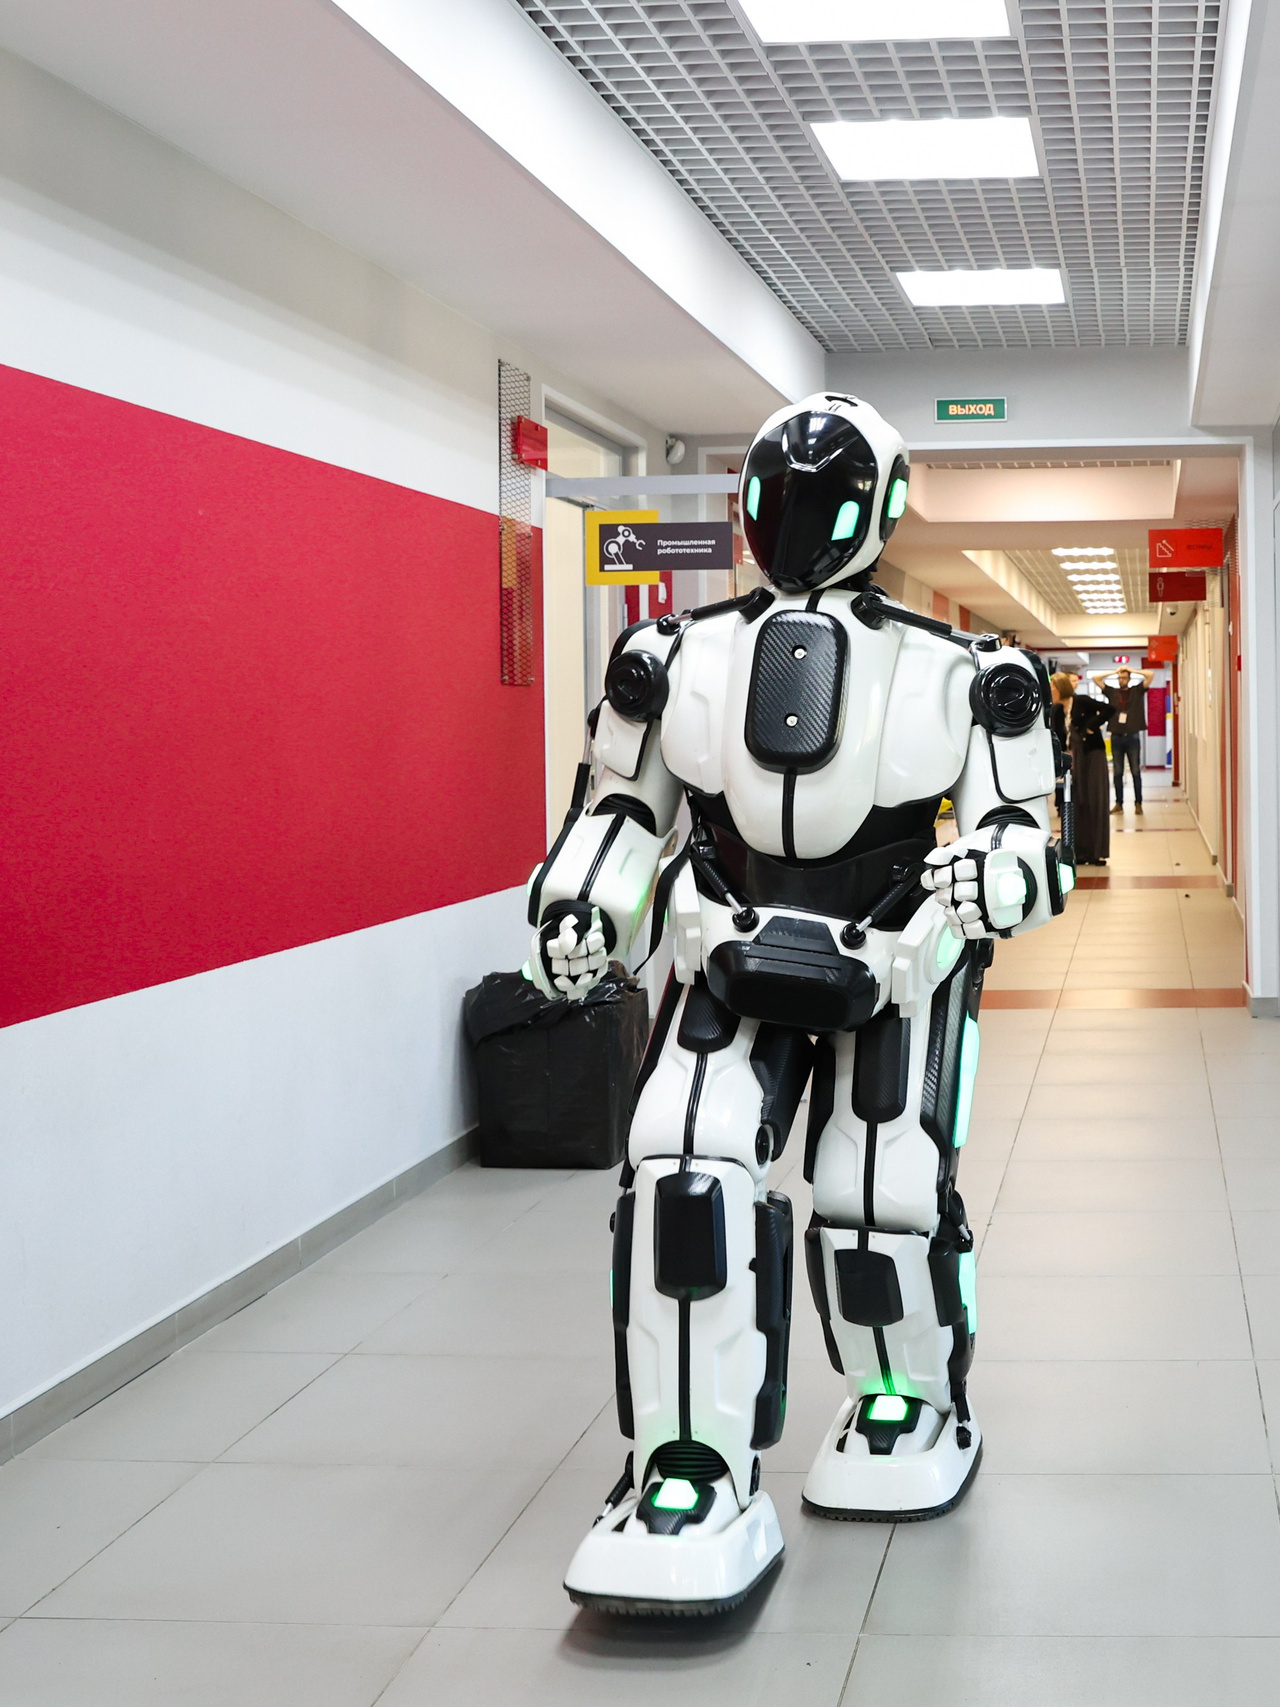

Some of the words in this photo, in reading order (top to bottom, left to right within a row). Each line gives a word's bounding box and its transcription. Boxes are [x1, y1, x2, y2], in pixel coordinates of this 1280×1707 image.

[948, 403, 994, 416] ВЫХОД
[657, 539, 716, 547] Промышленная
[657, 546, 713, 555] робототехника
